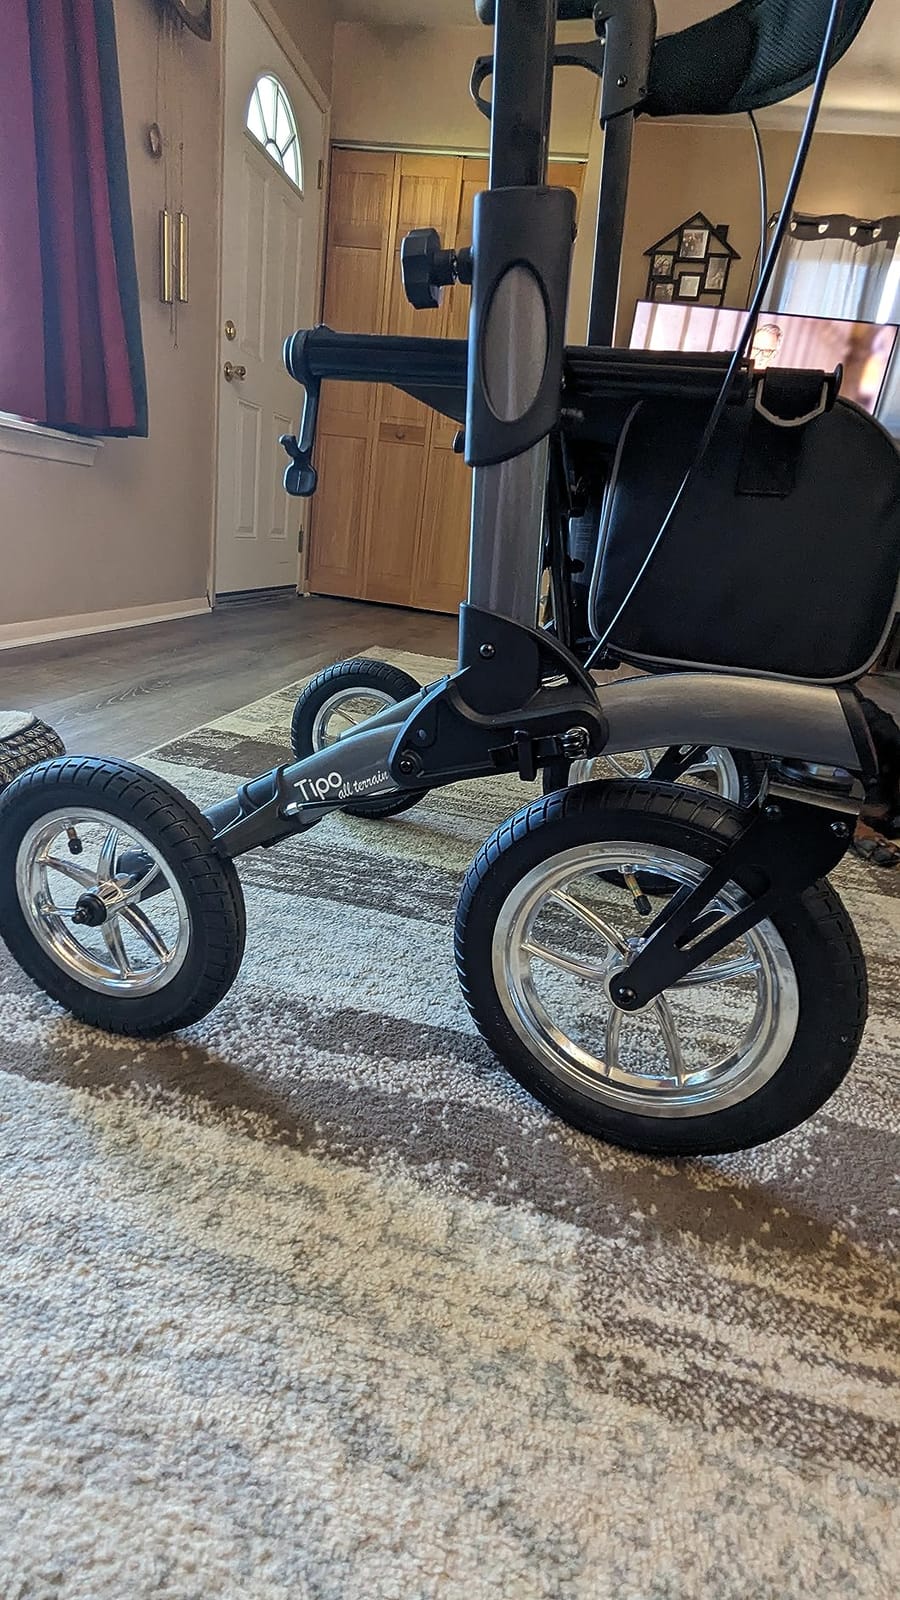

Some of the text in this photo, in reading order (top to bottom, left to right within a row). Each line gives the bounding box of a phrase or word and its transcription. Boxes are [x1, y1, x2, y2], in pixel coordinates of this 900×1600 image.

[293, 771, 343, 801] Tipo
[338, 770, 389, 800] all terrain
